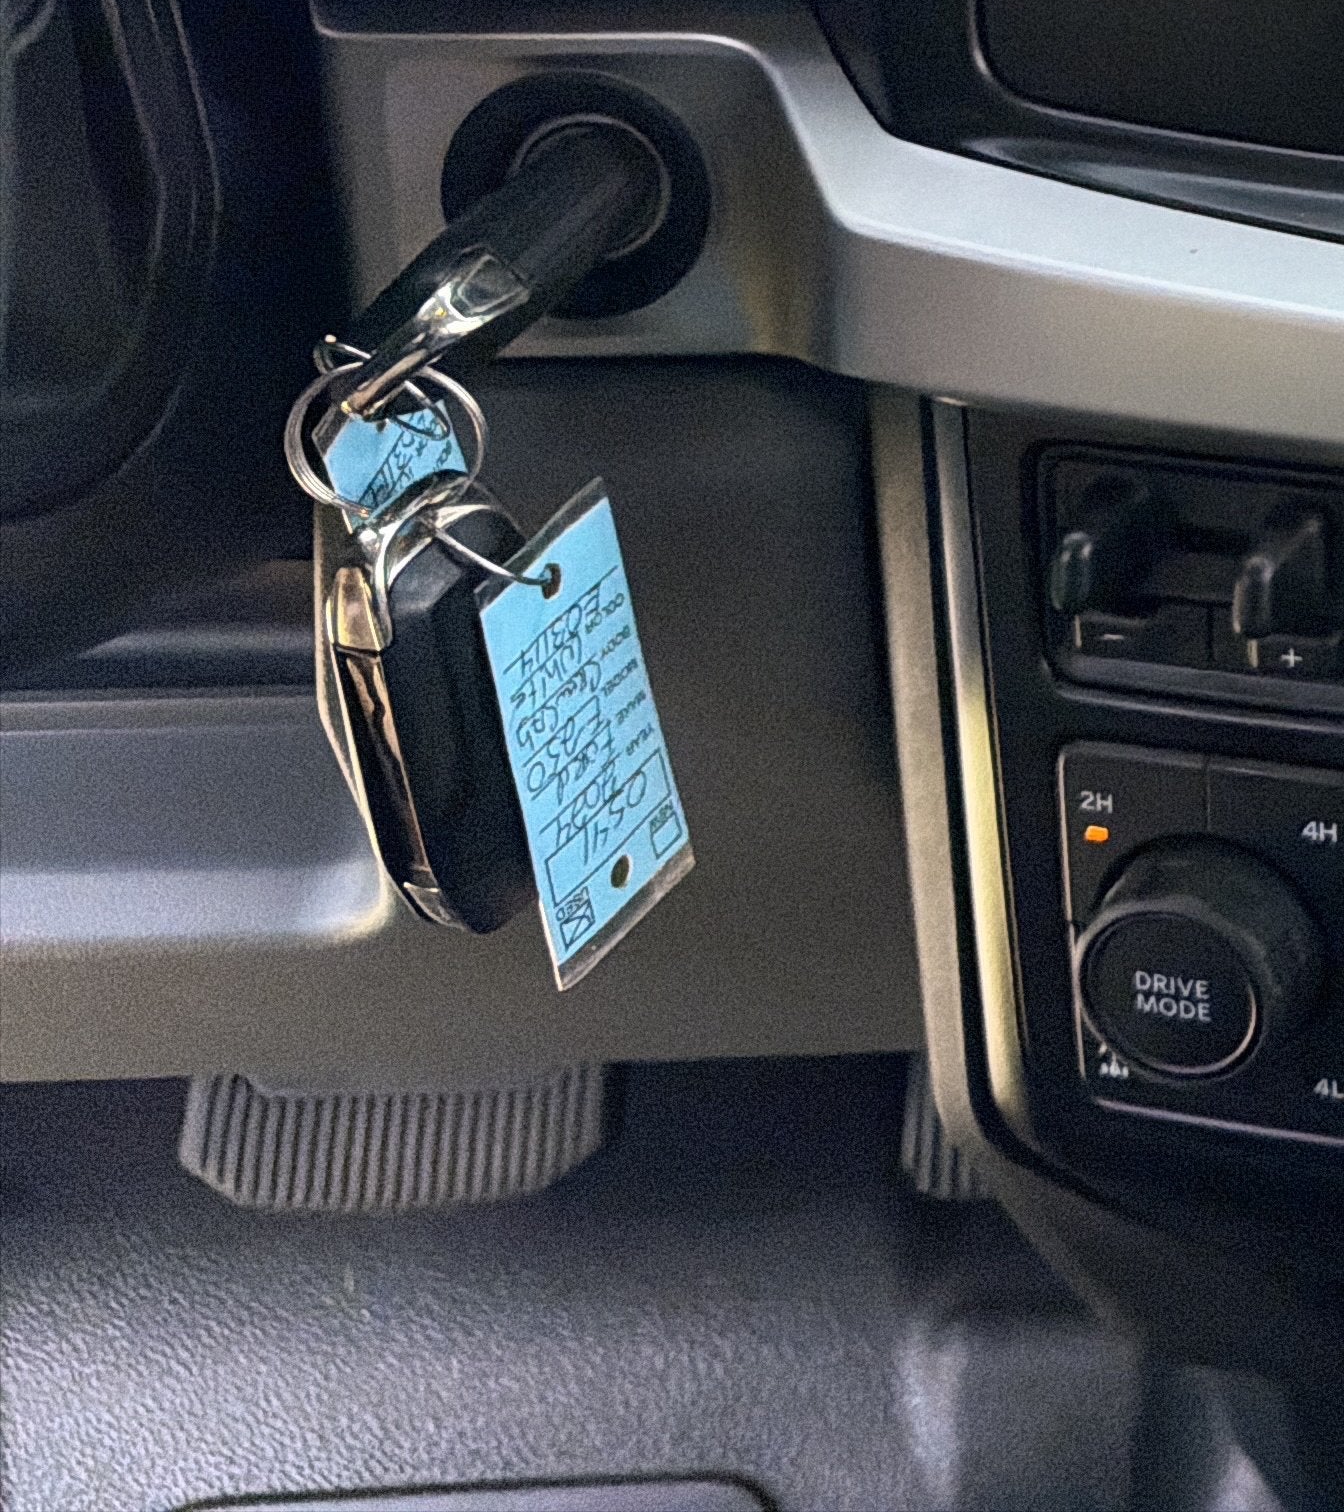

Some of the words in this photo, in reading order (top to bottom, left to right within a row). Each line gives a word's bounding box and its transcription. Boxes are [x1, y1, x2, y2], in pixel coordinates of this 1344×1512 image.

[1080, 790, 1113, 813] 2H
[1302, 821, 1338, 843] 4H
[556, 887, 588, 922] USED
[1134, 970, 1210, 999] DRIVE
[1136, 992, 1212, 1022] MODE
